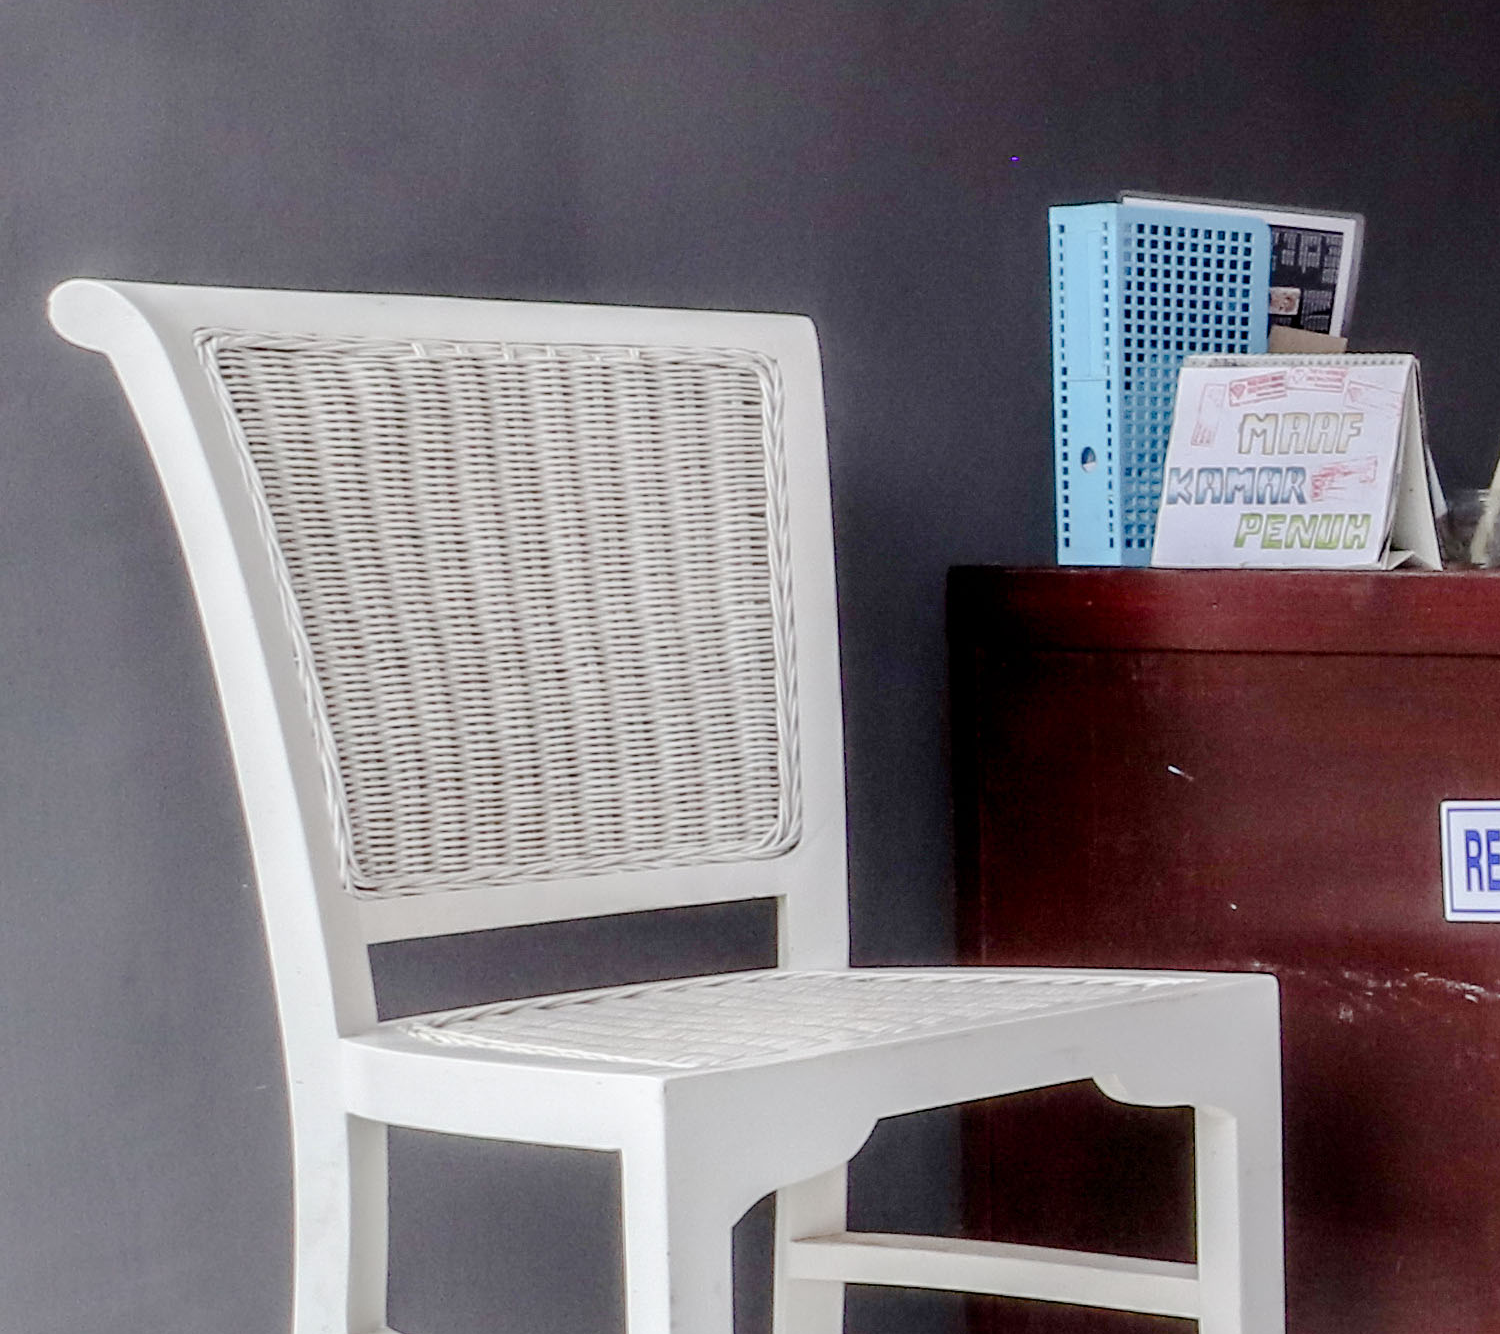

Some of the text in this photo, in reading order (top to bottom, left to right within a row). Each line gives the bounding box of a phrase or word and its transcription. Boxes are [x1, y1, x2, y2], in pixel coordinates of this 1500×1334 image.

[1238, 412, 1364, 455] MAAF
[1166, 466, 1307, 505] KAMAR
[1233, 512, 1371, 550] PENUH
